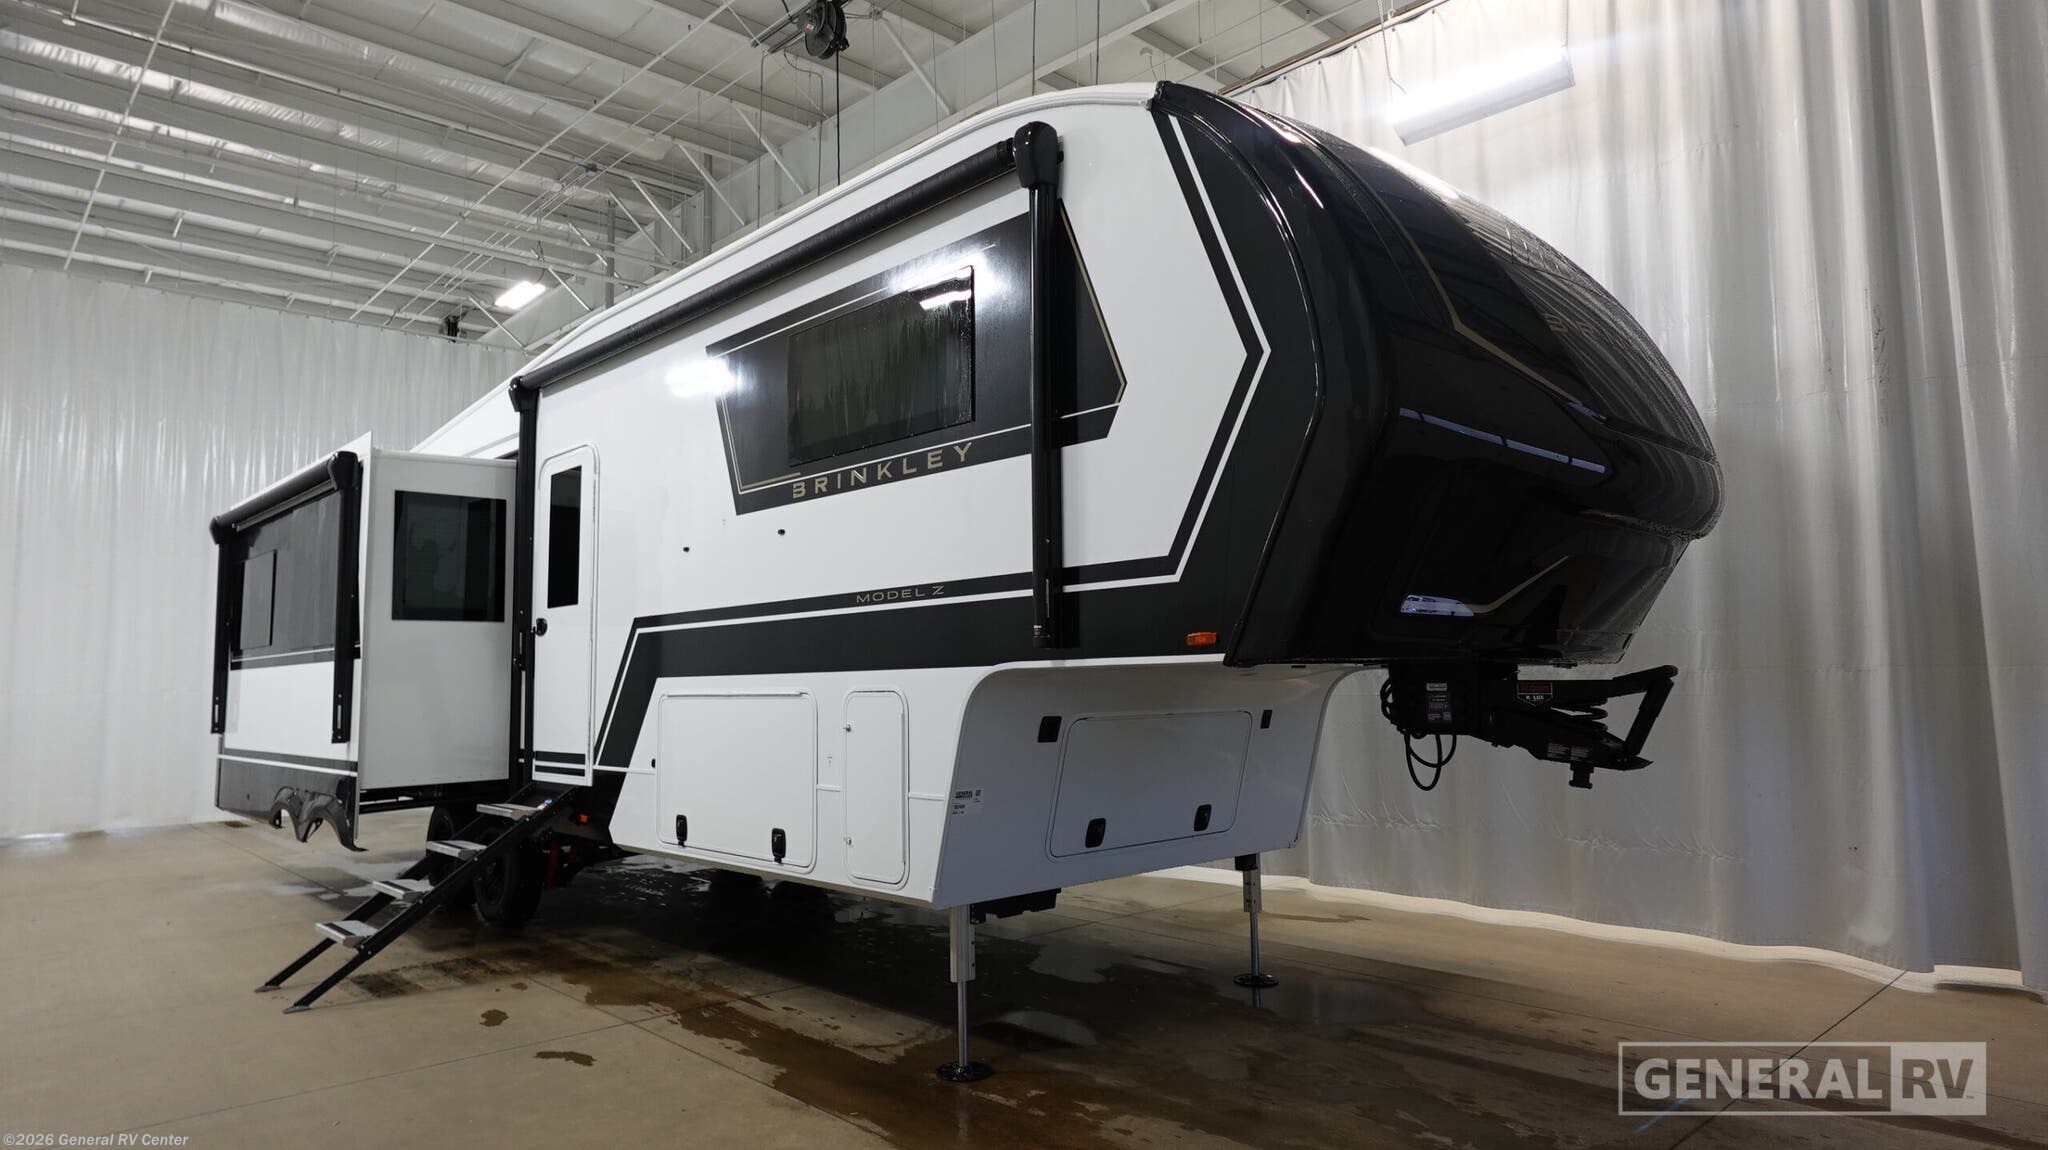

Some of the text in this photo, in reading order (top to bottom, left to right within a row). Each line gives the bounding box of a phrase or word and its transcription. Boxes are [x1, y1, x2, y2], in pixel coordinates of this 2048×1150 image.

[793, 442, 972, 499] BRINKLEY
[856, 585, 944, 604] MODEL Z
